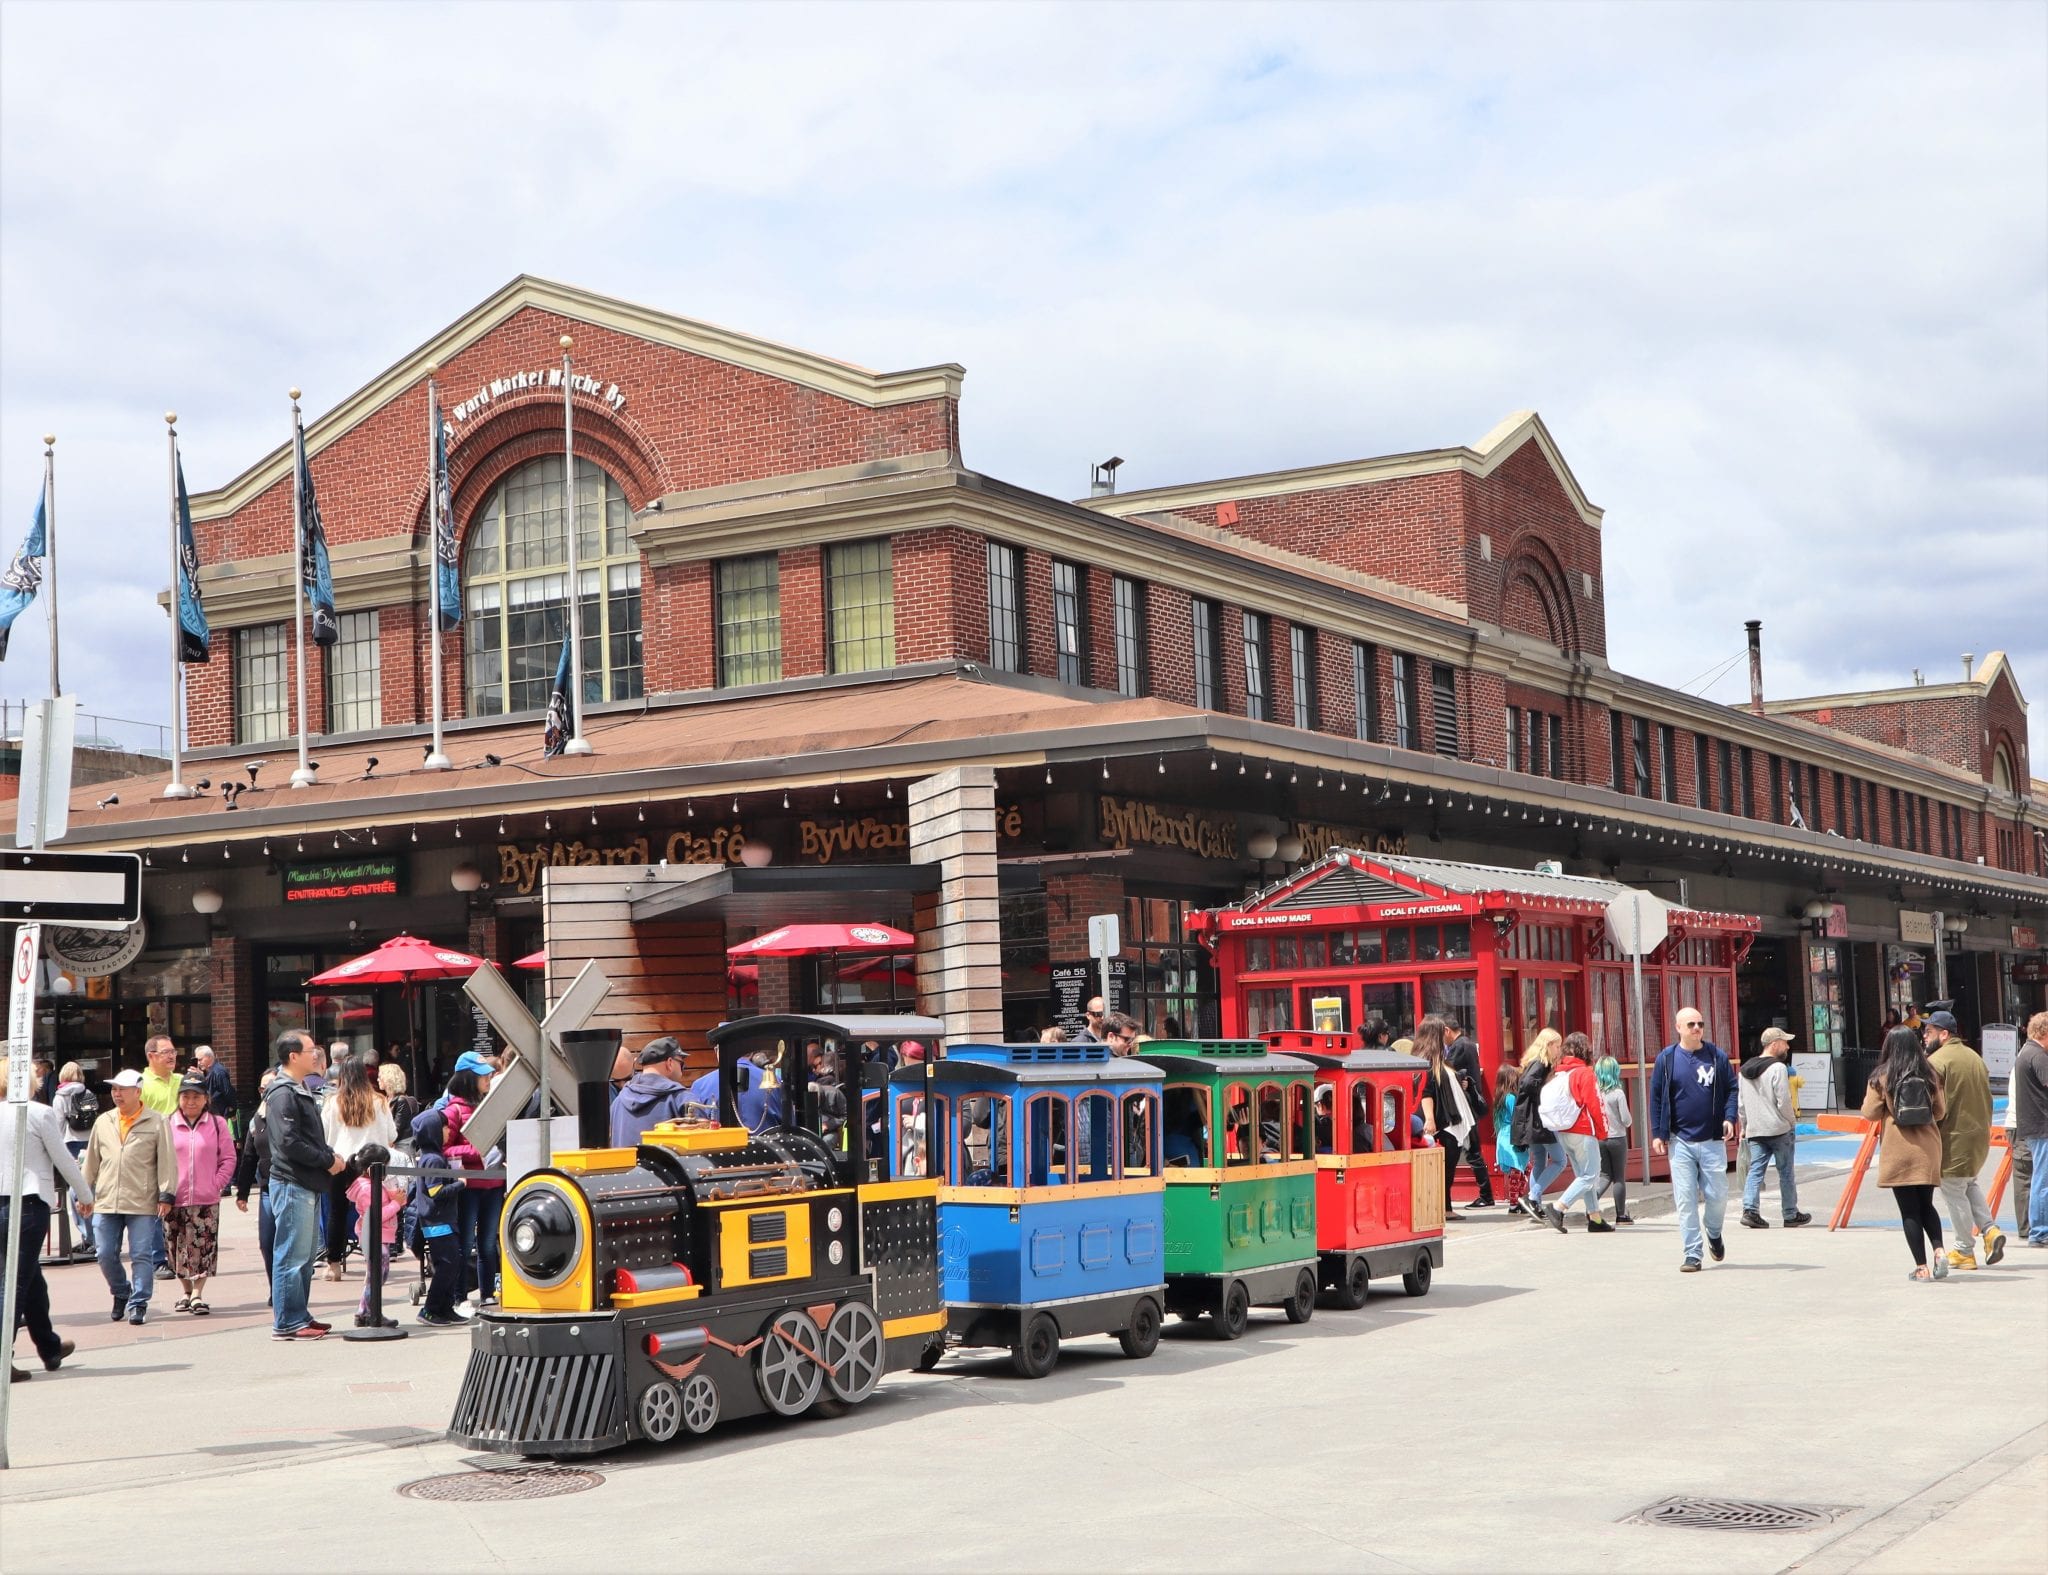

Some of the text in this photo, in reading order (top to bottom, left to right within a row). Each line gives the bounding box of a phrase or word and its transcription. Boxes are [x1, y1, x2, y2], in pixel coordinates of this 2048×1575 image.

[453, 386, 490, 423] Ward
[490, 369, 545, 398] Market
[605, 383, 627, 411] By
[1100, 795, 1239, 860] ByWard Café
[800, 817, 908, 865] ByWar
[497, 824, 747, 895] ByWard Café
[1231, 913, 1312, 927] LOCAL & HAND MADE
[1380, 903, 1463, 917] LOCAL ET ARTISANAL
[49, 942, 136, 973] CHOCOLATE FACTORY
[1115, 962, 1126, 973] 55
[1053, 967, 1086, 977] Café 55
[1696, 1065, 1715, 1087] NY
